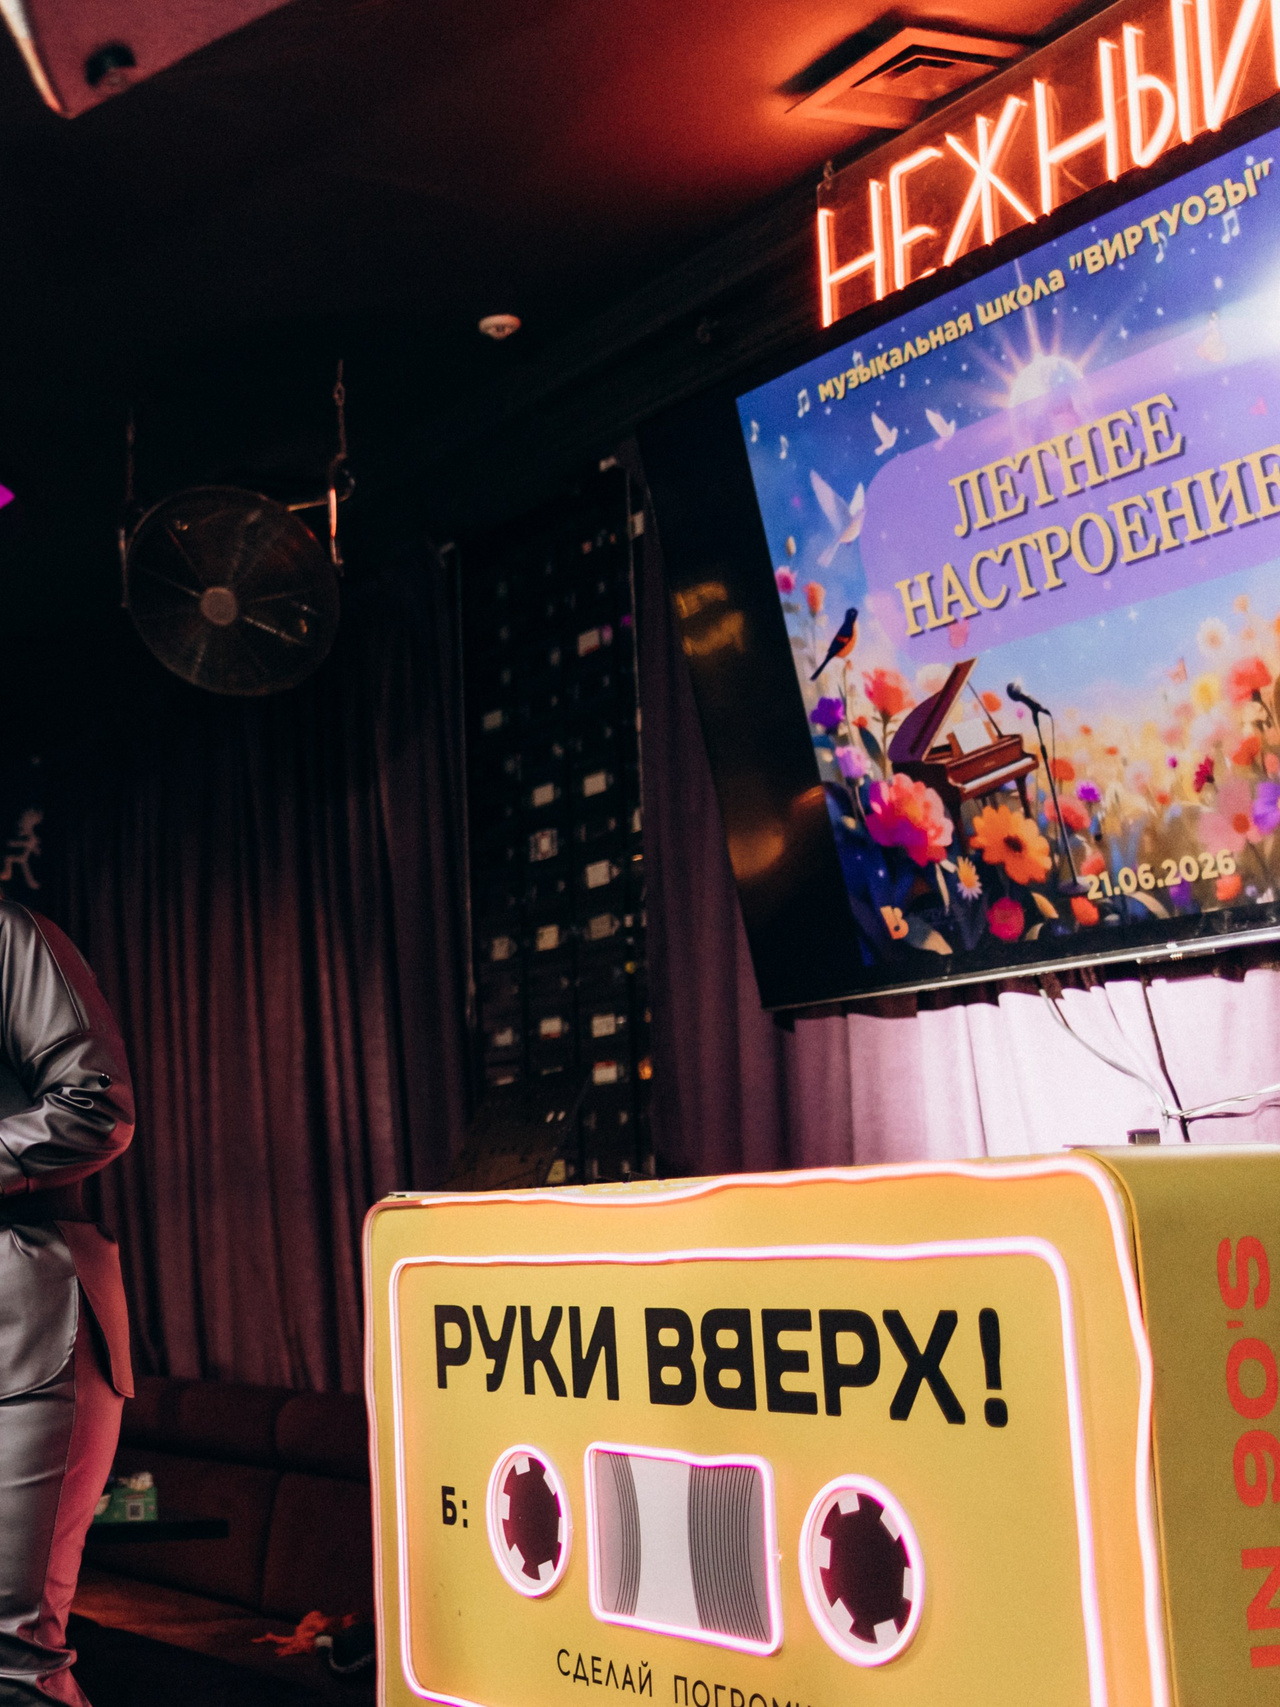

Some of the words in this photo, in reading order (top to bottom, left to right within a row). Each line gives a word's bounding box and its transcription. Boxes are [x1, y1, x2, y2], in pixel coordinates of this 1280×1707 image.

[818, 311, 974, 403] музыкальная
[975, 268, 1066, 326] школа
[1068, 159, 1271, 275] "ВИРТУОЗЫ"
[948, 393, 1184, 538] ЛЕТНЕЕ
[895, 443, 1280, 637] НАСТРОЕНИЕ
[1086, 849, 1237, 900] 21.06.2026
[434, 1304, 620, 1401] РУКИ
[557, 1648, 652, 1697] СДЕЛАЙ
